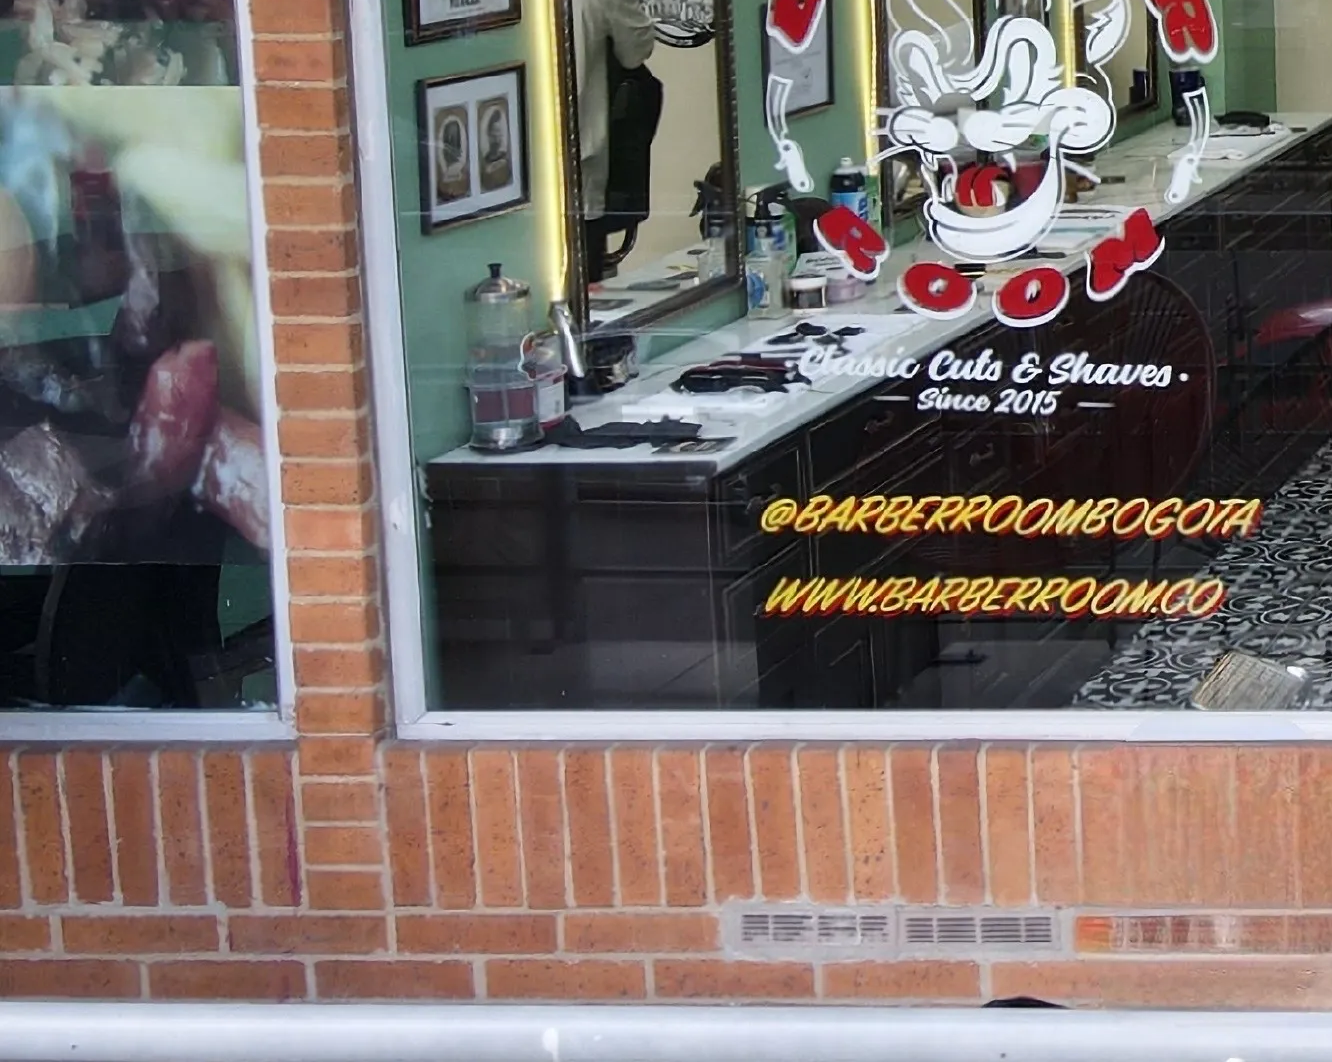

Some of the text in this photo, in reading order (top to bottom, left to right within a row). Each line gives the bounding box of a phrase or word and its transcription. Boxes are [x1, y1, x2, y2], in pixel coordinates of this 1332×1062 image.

[814, 206, 1165, 328] ROOM
[799, 346, 1172, 388] Classic Cuts & Shaves
[917, 387, 1062, 415] Since 2015
[761, 494, 1262, 538] @BARBERROOMBOGOTA
[762, 576, 1227, 619] WWW.BARBERROOM.CO
